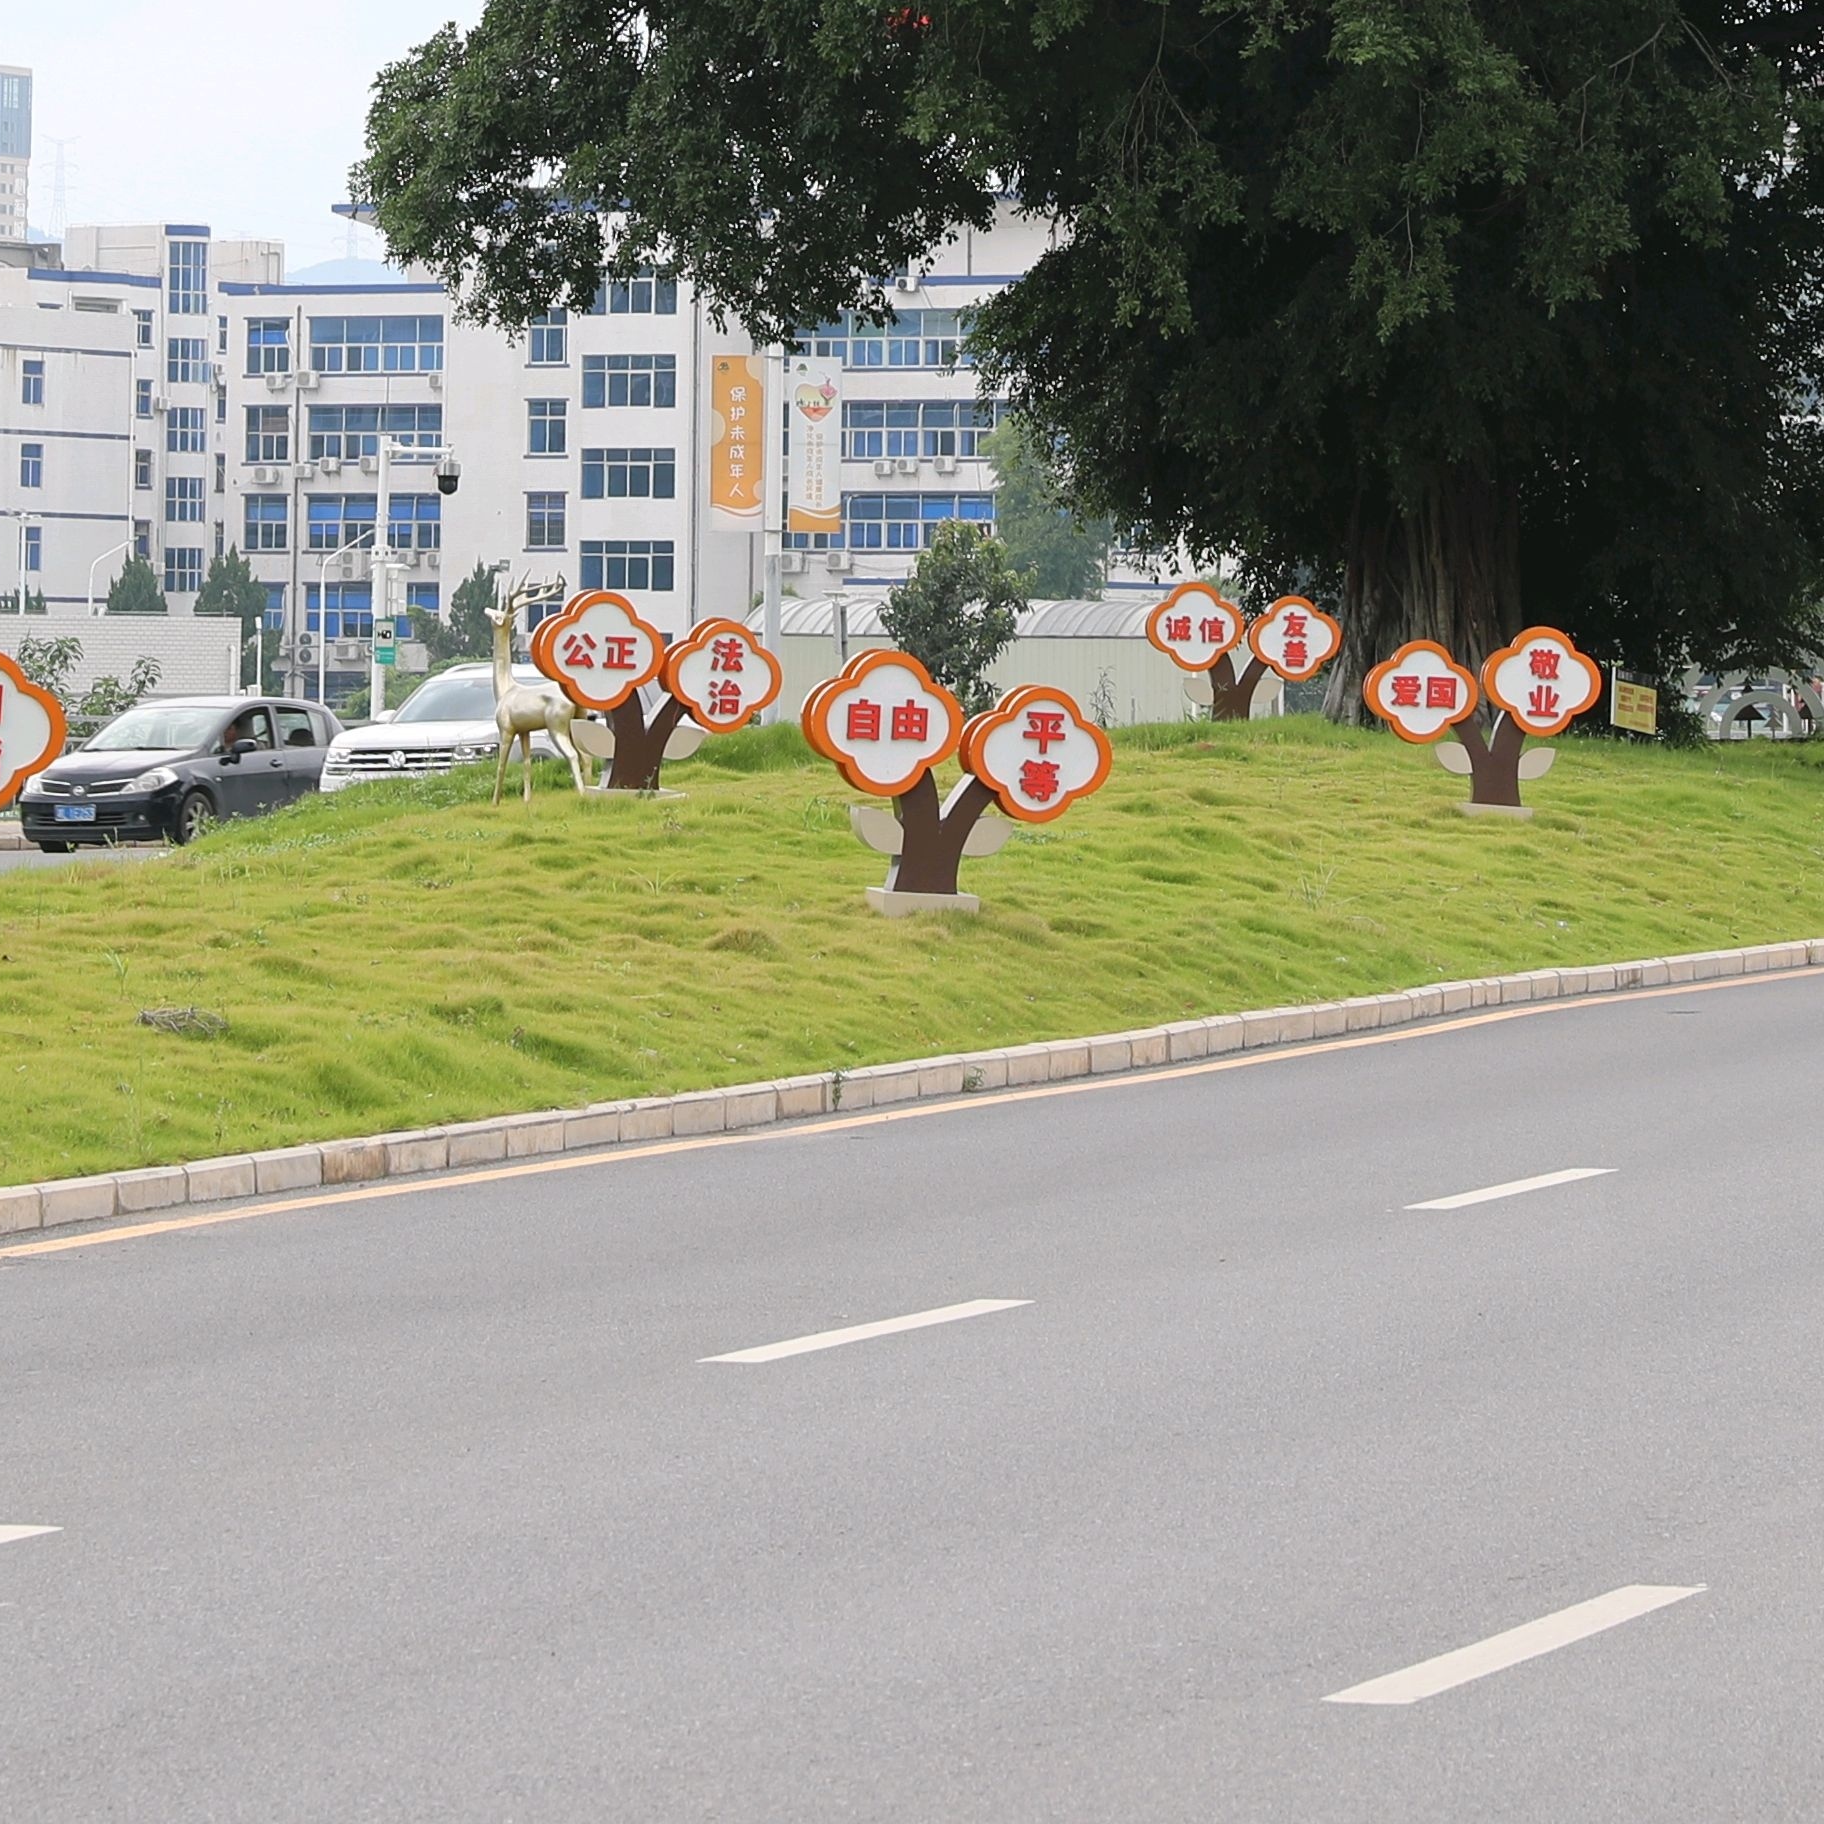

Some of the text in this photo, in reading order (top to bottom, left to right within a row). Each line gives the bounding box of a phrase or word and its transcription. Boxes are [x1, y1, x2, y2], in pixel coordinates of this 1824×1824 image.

[729, 386, 747, 498] 保护未成年人
[563, 634, 637, 670] 公正
[1166, 615, 1225, 643] 诚信
[1282, 612, 1308, 667] 友善
[707, 638, 743, 716] 法治
[1392, 675, 1457, 708] 爱国
[1527, 648, 1560, 718] 敬业
[846, 699, 928, 742] 自由
[1019, 711, 1066, 803] 平等
